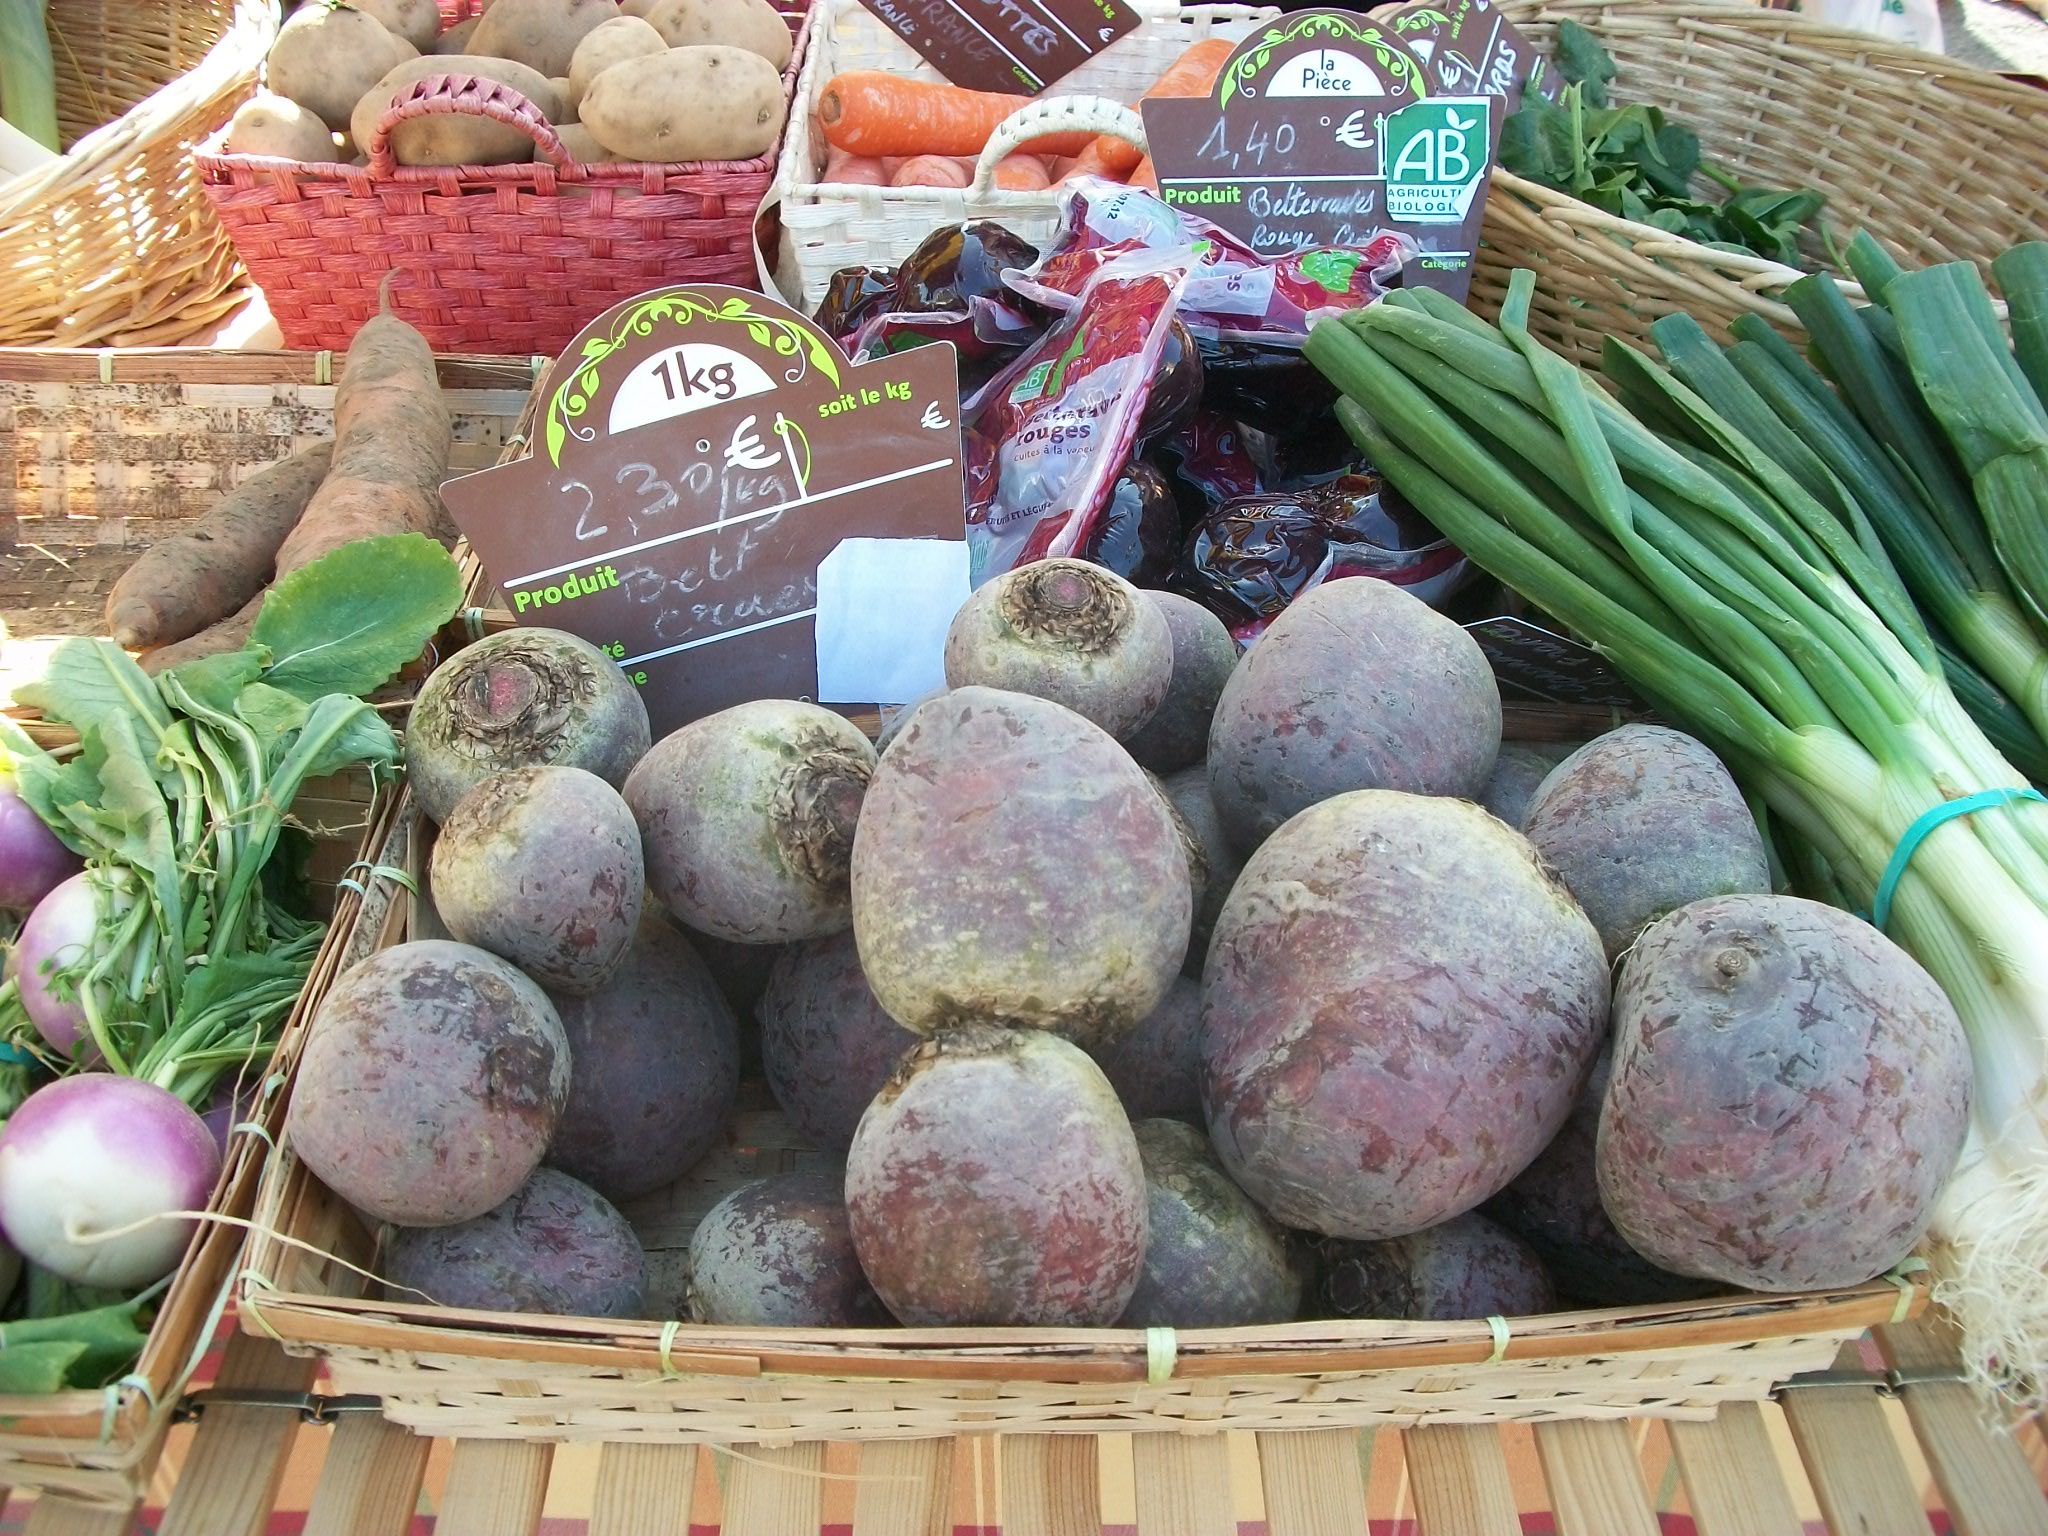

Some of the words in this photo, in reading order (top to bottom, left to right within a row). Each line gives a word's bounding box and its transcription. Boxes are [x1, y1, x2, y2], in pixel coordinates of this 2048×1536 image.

[1103, 4, 1116, 19] kg
[980, 0, 1059, 55] TTES
[1321, 49, 1335, 71] la
[1303, 68, 1351, 91] Pièce
[1197, 115, 1296, 170] 1,40
[1393, 128, 1470, 181] AB
[1165, 185, 1241, 205] Produit
[651, 350, 737, 400] 1kg
[818, 393, 857, 418] soit
[861, 388, 881, 406] le
[885, 381, 913, 402] kg
[1015, 424, 1091, 447] rouges
[1014, 449, 1040, 462] cuites
[1043, 445, 1051, 455] à
[1053, 445, 1063, 455] la
[513, 565, 620, 613] Produit
